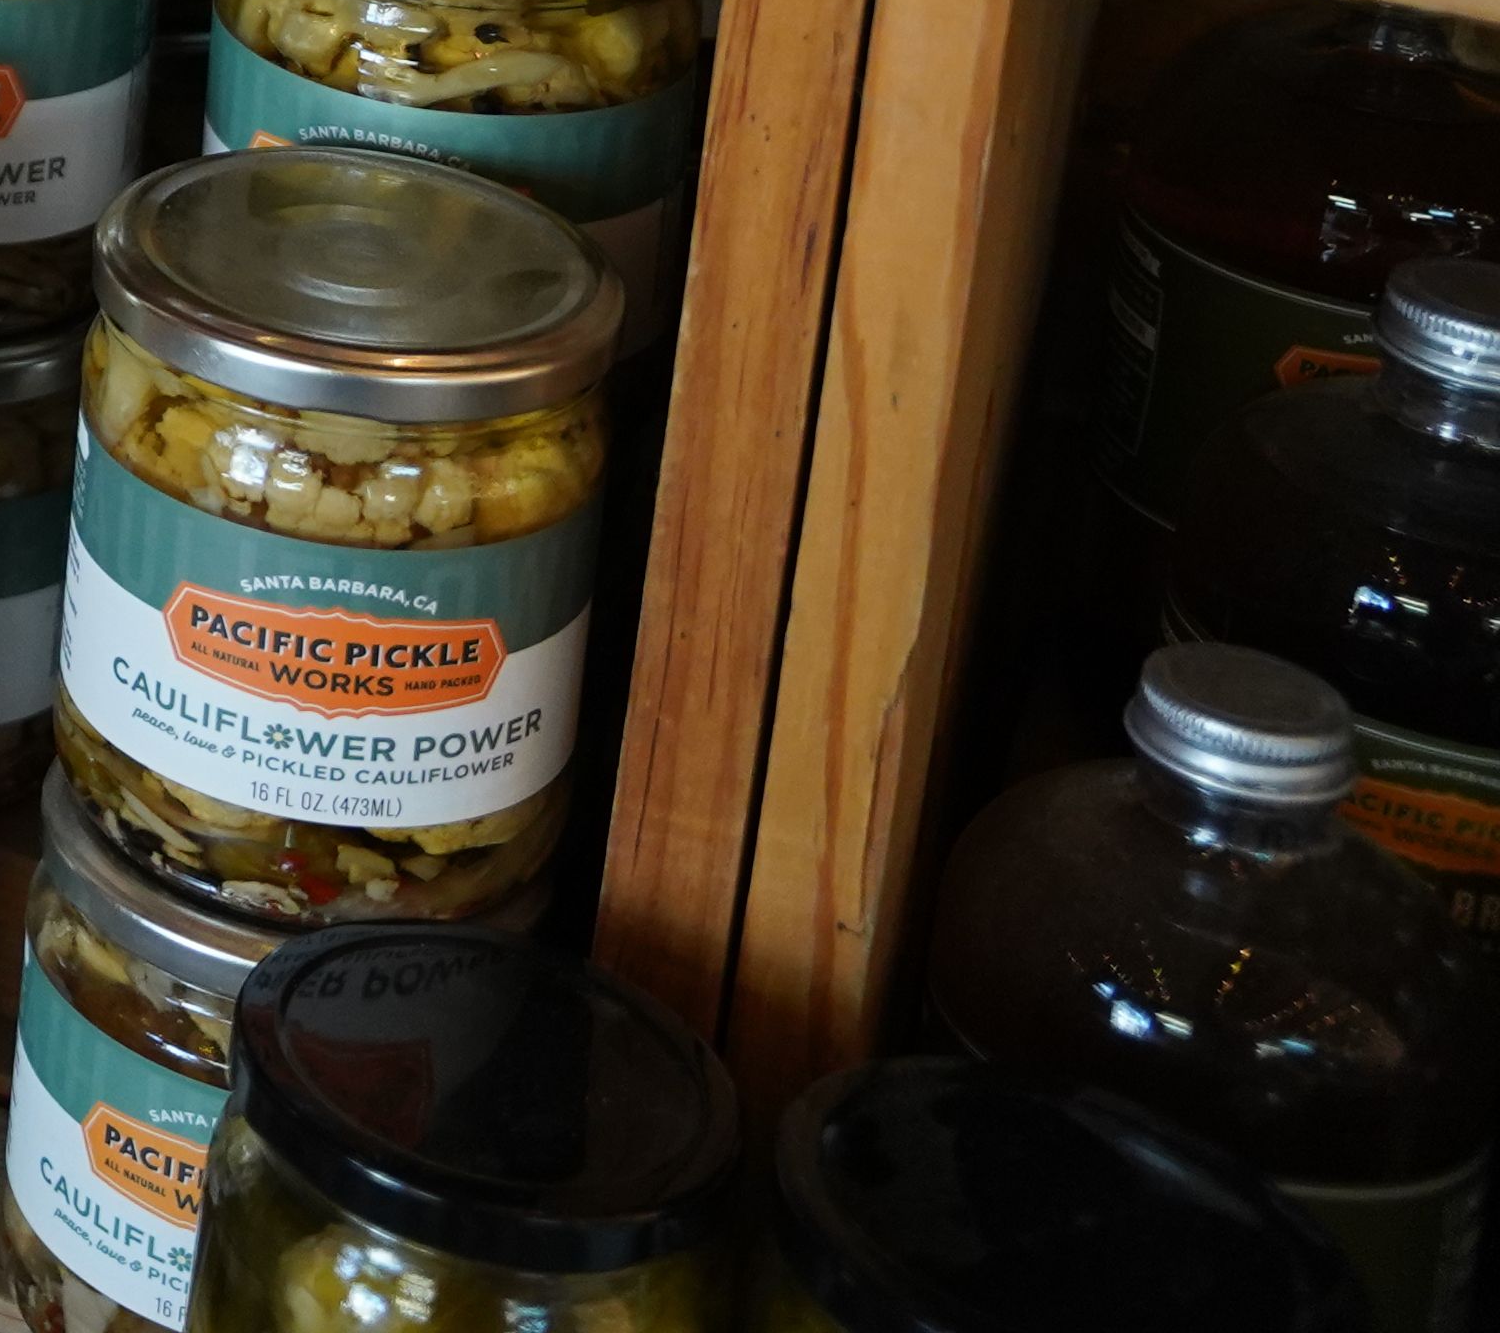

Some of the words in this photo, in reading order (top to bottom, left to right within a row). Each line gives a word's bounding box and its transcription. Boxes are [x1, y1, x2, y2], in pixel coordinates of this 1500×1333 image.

[299, 125, 351, 142] SANTA
[240, 574, 305, 594] SANTA
[413, 595, 439, 615] CA
[189, 604, 334, 666] PACIFIC
[344, 638, 481, 669] PICKLE
[268, 660, 395, 697] WORKS
[131, 706, 179, 743] peace,
[183, 731, 218, 756] love
[221, 744, 236, 759] &
[242, 750, 346, 783] PICKLED
[354, 751, 515, 786] CAULIFLOWER
[413, 708, 543, 762] POWER
[149, 1109, 208, 1127] SANTA
[104, 1158, 121, 1175] ALL
[123, 1169, 166, 1197] NATURAL
[54, 1207, 93, 1246] peace,
[95, 1241, 127, 1266] love
[129, 1260, 144, 1273] &
[154, 1296, 172, 1318] 16
